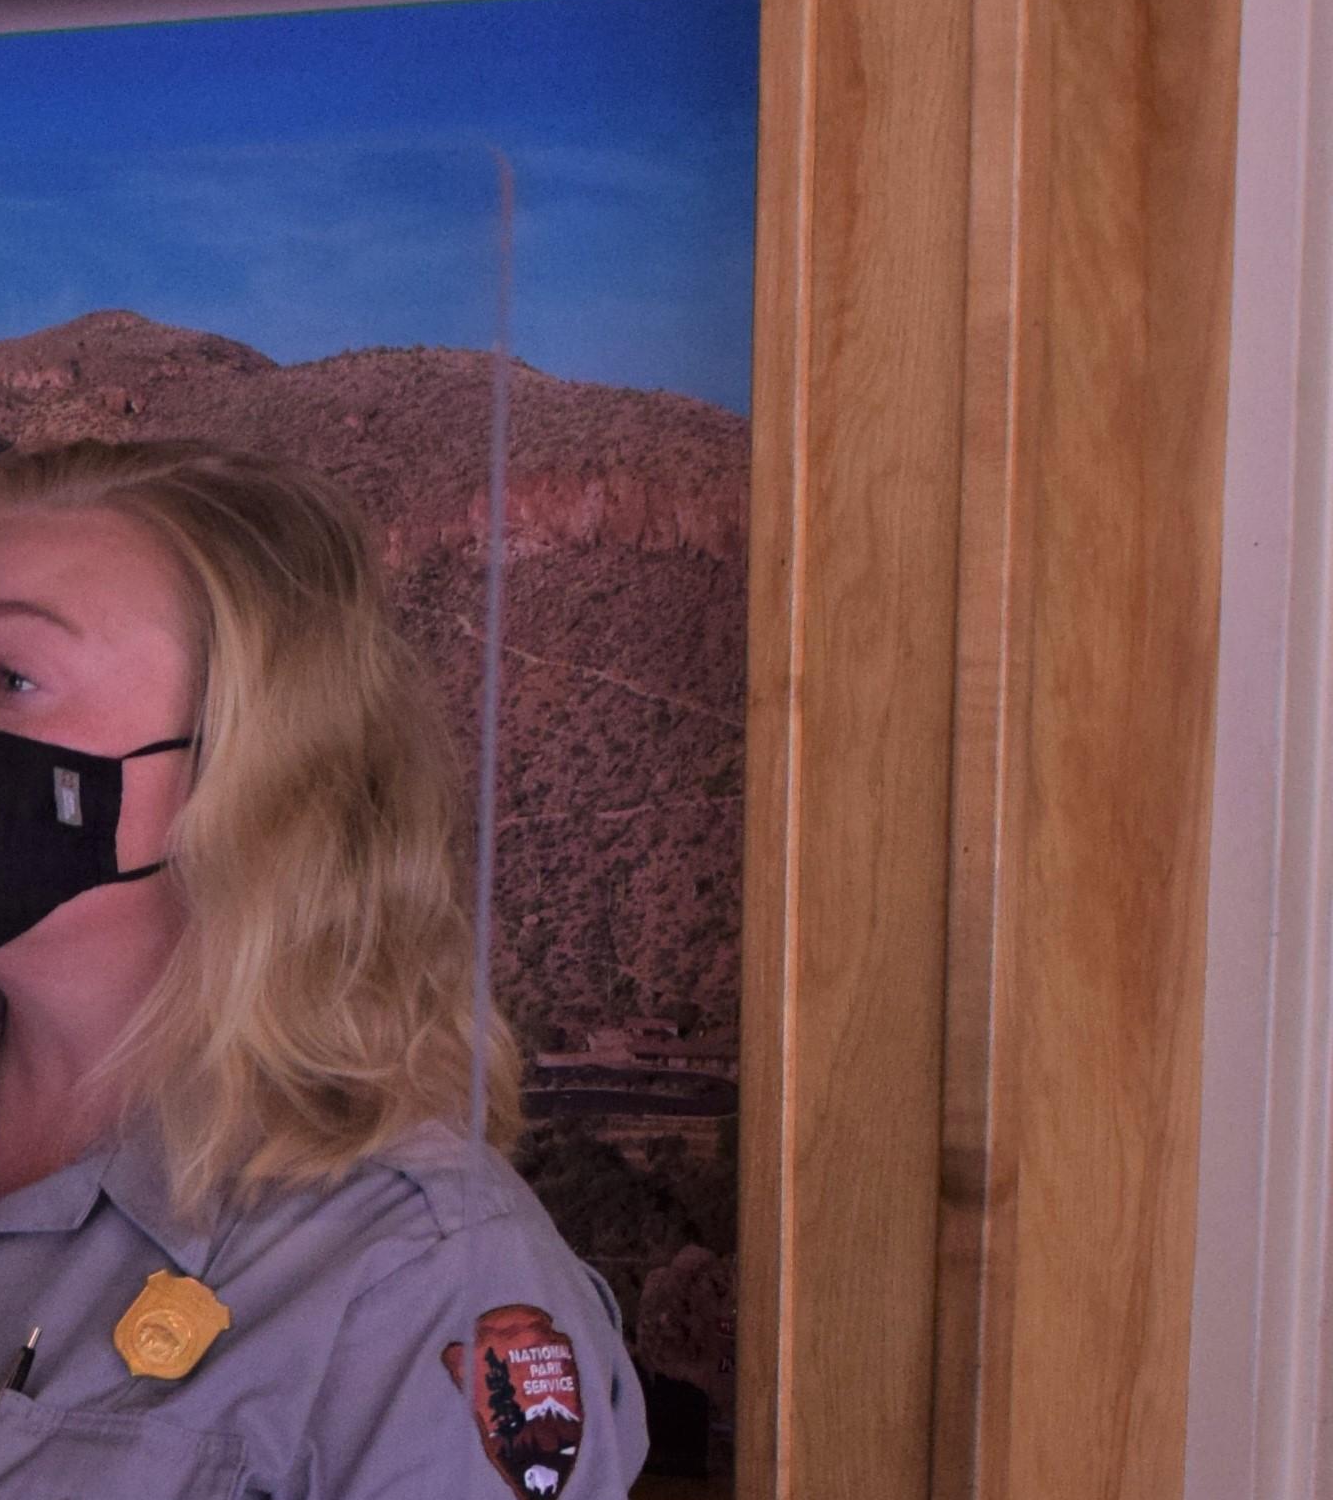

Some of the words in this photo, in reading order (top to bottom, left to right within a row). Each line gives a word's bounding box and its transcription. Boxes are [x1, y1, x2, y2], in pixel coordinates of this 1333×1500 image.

[508, 1344, 573, 1364] NATIONAL
[529, 1361, 564, 1378] PARK
[523, 1375, 575, 1396] SERVICE
